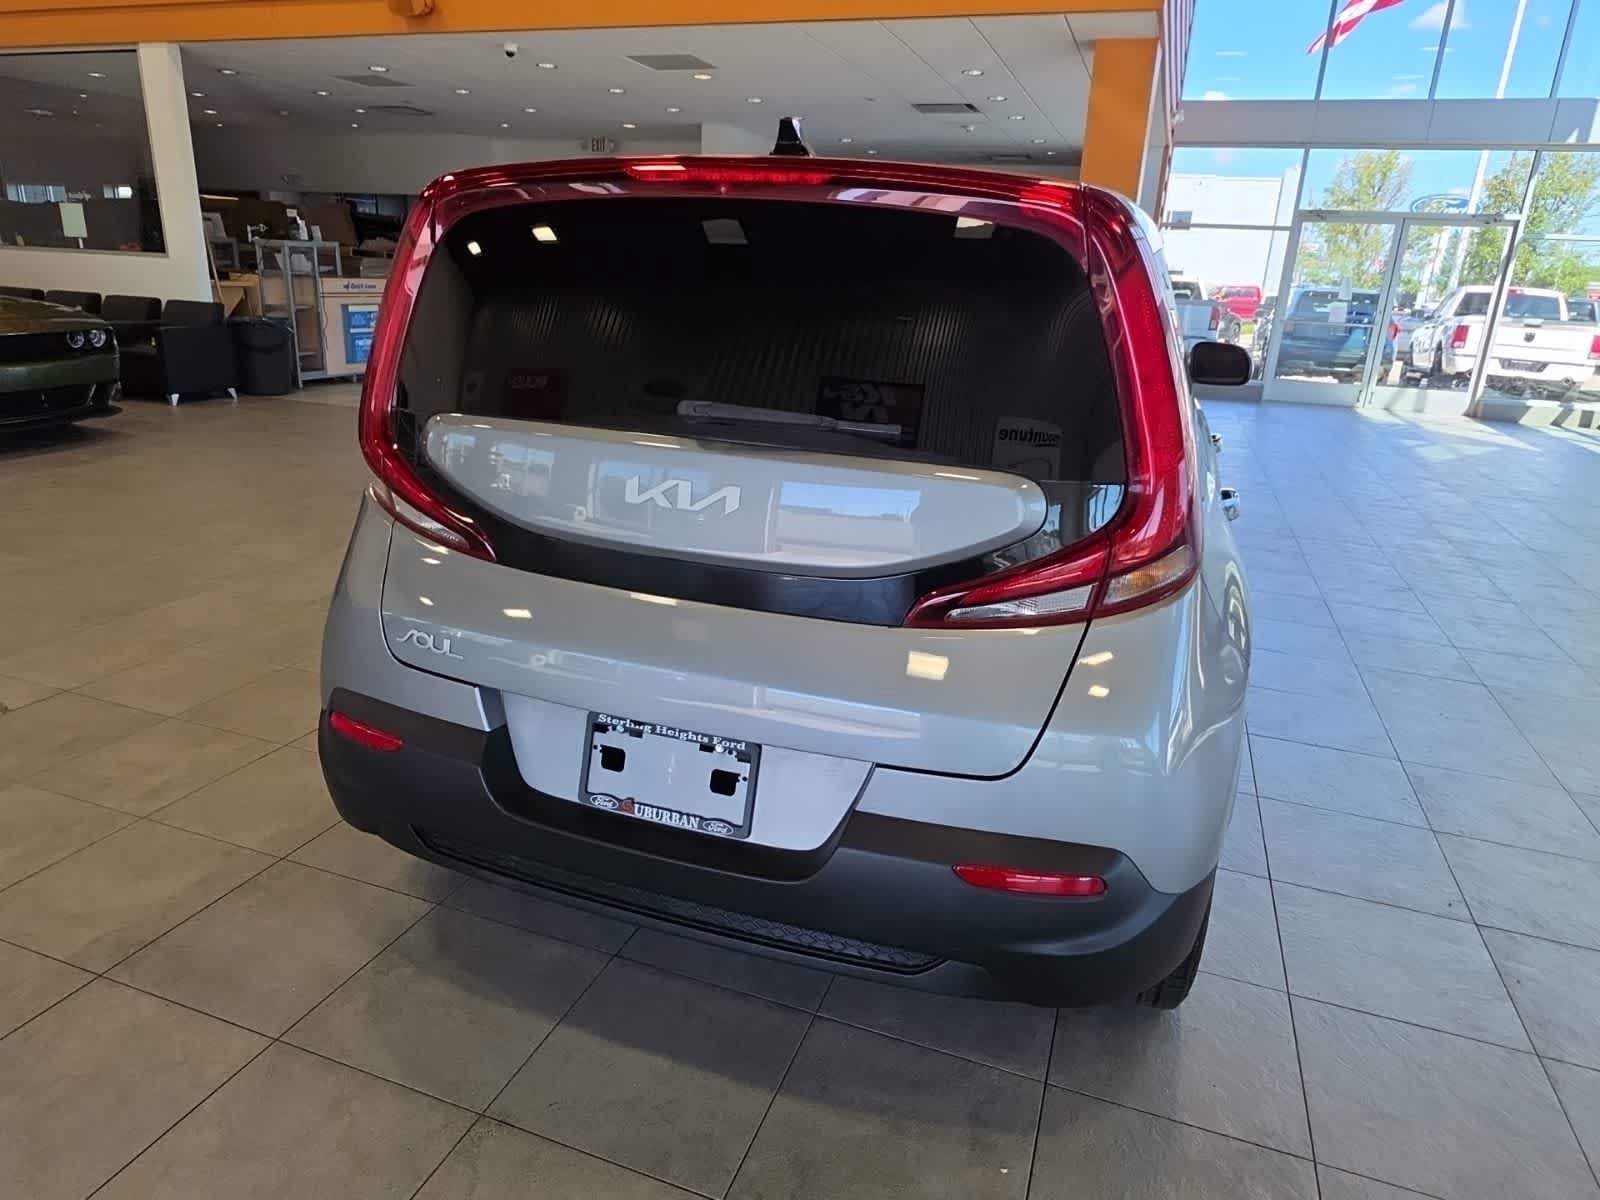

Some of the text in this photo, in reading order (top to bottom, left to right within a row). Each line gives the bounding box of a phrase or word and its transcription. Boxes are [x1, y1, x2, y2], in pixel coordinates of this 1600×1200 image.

[655, 725, 709, 744] Heights
[712, 736, 747, 751] Ford
[596, 796, 616, 808] Ford
[707, 821, 729, 834] Ford
